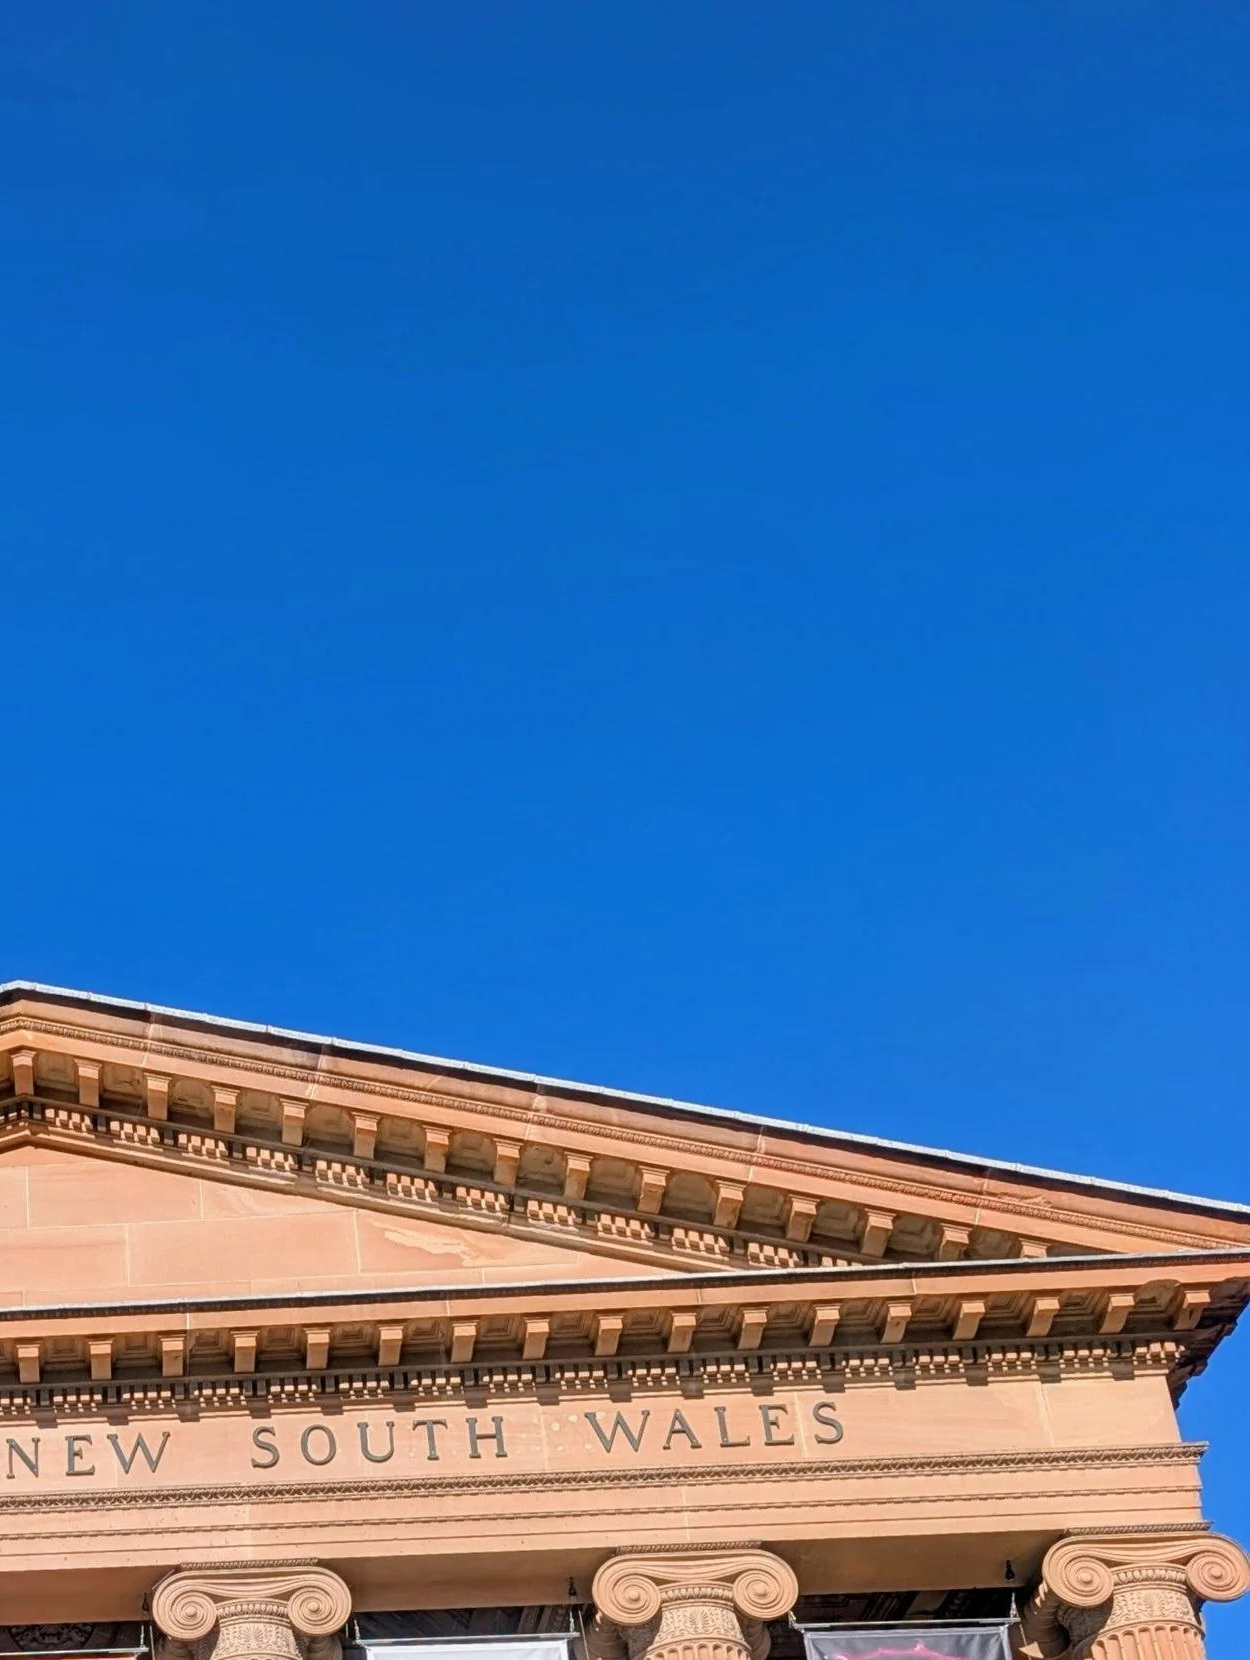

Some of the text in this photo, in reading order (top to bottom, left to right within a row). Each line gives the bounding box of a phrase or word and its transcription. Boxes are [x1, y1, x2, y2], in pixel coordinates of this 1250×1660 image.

[6, 1431, 171, 1480] NEW
[250, 1416, 508, 1469] SOUTH
[584, 1401, 844, 1454] WALES
